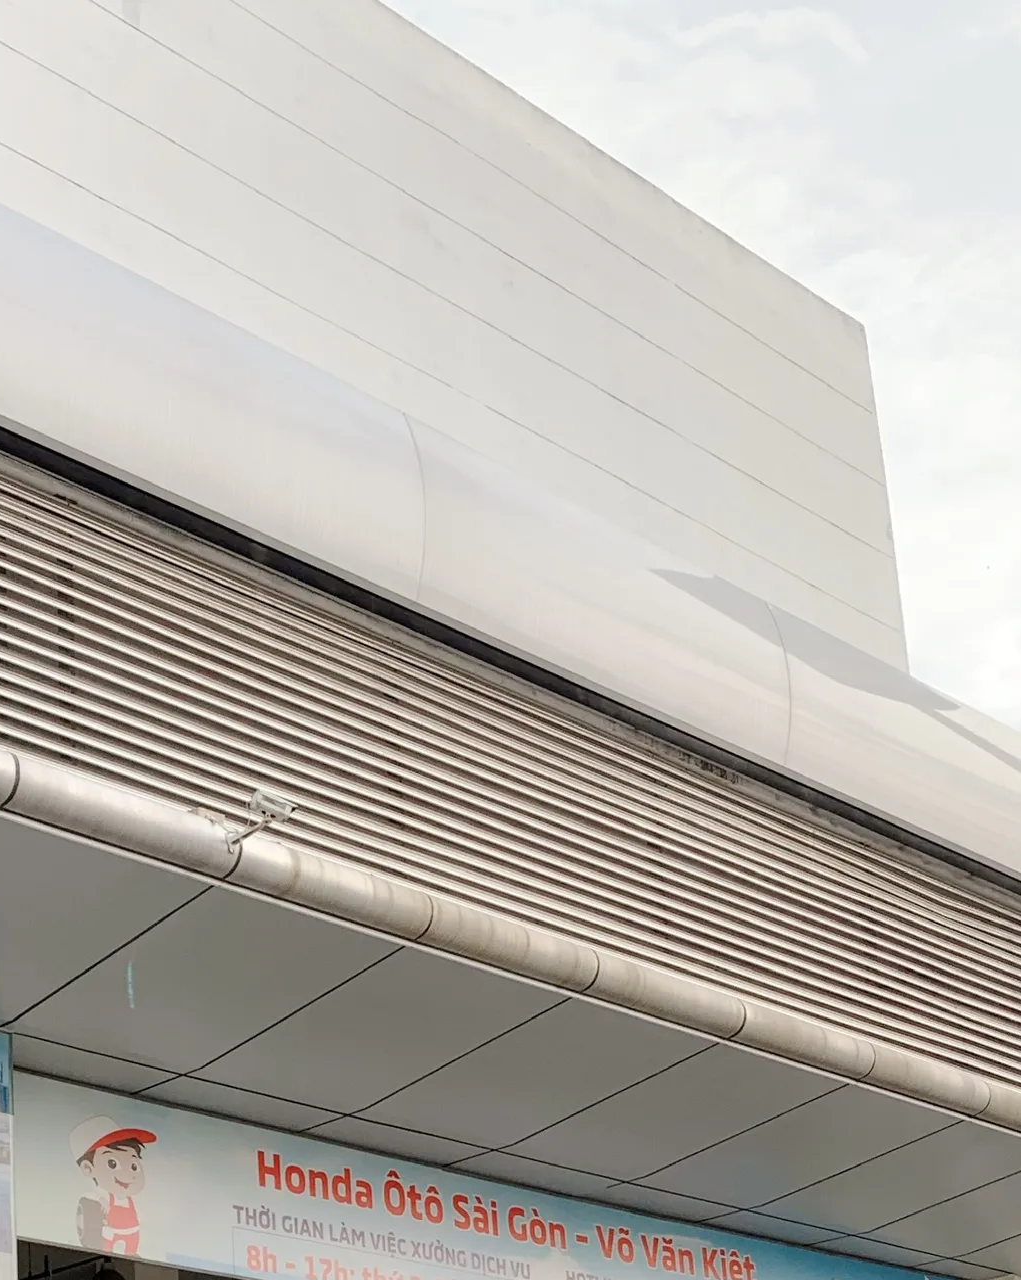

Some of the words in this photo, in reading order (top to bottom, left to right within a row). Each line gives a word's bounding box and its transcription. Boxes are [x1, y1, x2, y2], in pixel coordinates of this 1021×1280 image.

[233, 1205, 276, 1231] THỜI
[282, 1216, 324, 1240] GIAN
[329, 1222, 366, 1248] LÀM
[370, 1232, 407, 1257] VIỆC
[412, 1239, 467, 1267] XƯỞNG
[471, 1253, 506, 1276] DỊCH
[257, 1150, 374, 1209] Honda
[384, 1170, 444, 1224] Ôtô
[452, 1194, 499, 1236] Sài
[508, 1206, 567, 1249] Gòn
[575, 1233, 588, 1244] -
[595, 1225, 635, 1264] Võ
[640, 1233, 695, 1276] Văn
[246, 1244, 277, 1273] 8h
[285, 1261, 296, 1270] -
